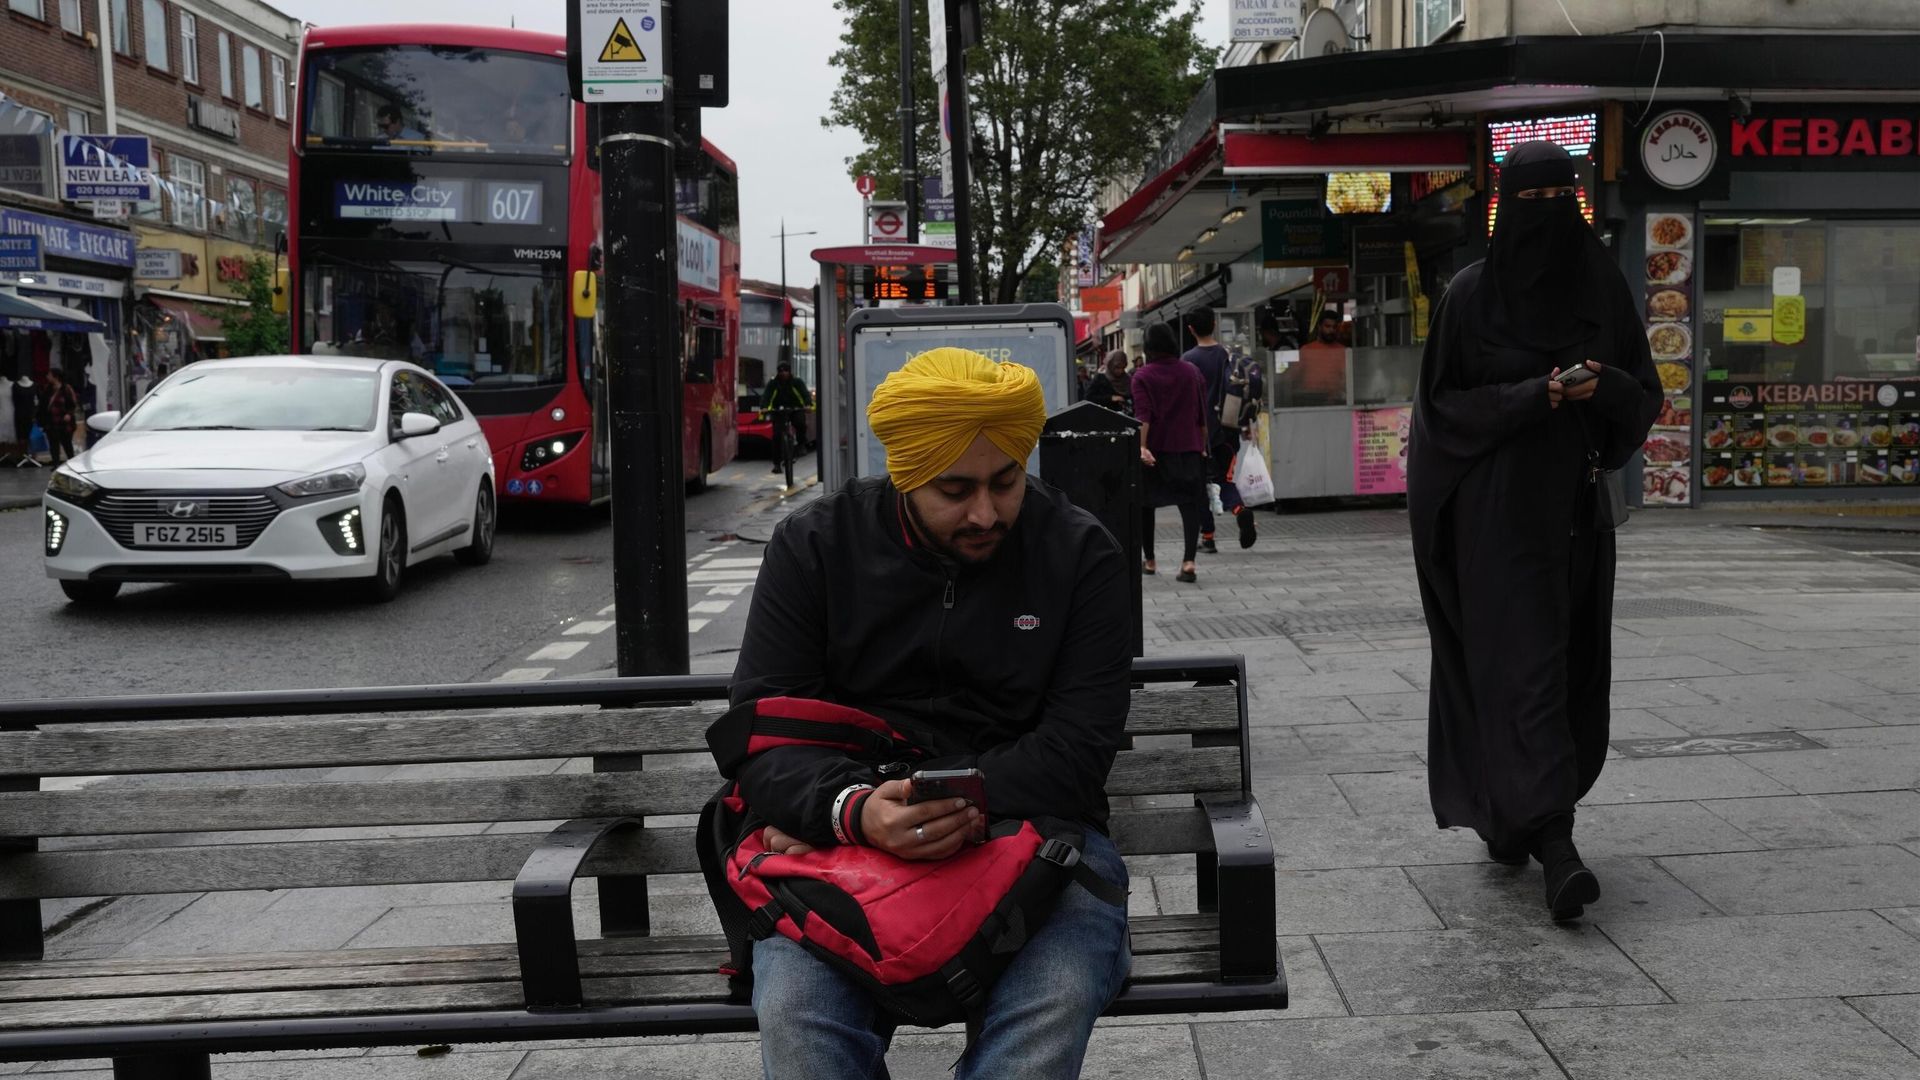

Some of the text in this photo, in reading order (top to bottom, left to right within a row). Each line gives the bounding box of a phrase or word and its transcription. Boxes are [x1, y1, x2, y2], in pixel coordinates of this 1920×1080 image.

[1237, 17, 1294, 25] ACCOUNTANTS
[1234, 27, 1297, 37] 081 571 9594
[1648, 116, 1709, 146] KEBABISH
[1731, 116, 1920, 158] KEBAB
[1661, 143, 1698, 162] حلال
[67, 169, 149, 183] NEW LEAE
[76, 186, 93, 195] 020
[862, 177, 870, 193] J
[344, 183, 453, 208] White City
[491, 188, 535, 221] 607
[364, 207, 433, 217] LIMITED STOP
[79, 231, 129, 260] EYECARE
[136, 251, 171, 259] CONTACT
[513, 248, 563, 260] VMH2594
[888, 249, 914, 257] Broadway
[58, 277, 83, 289] CONTACT
[1757, 384, 1875, 403] KEBABISH
[1814, 403, 1844, 411] Takeaway
[1844, 403, 1864, 411] Prices
[145, 526, 226, 544] FGZ 2515
